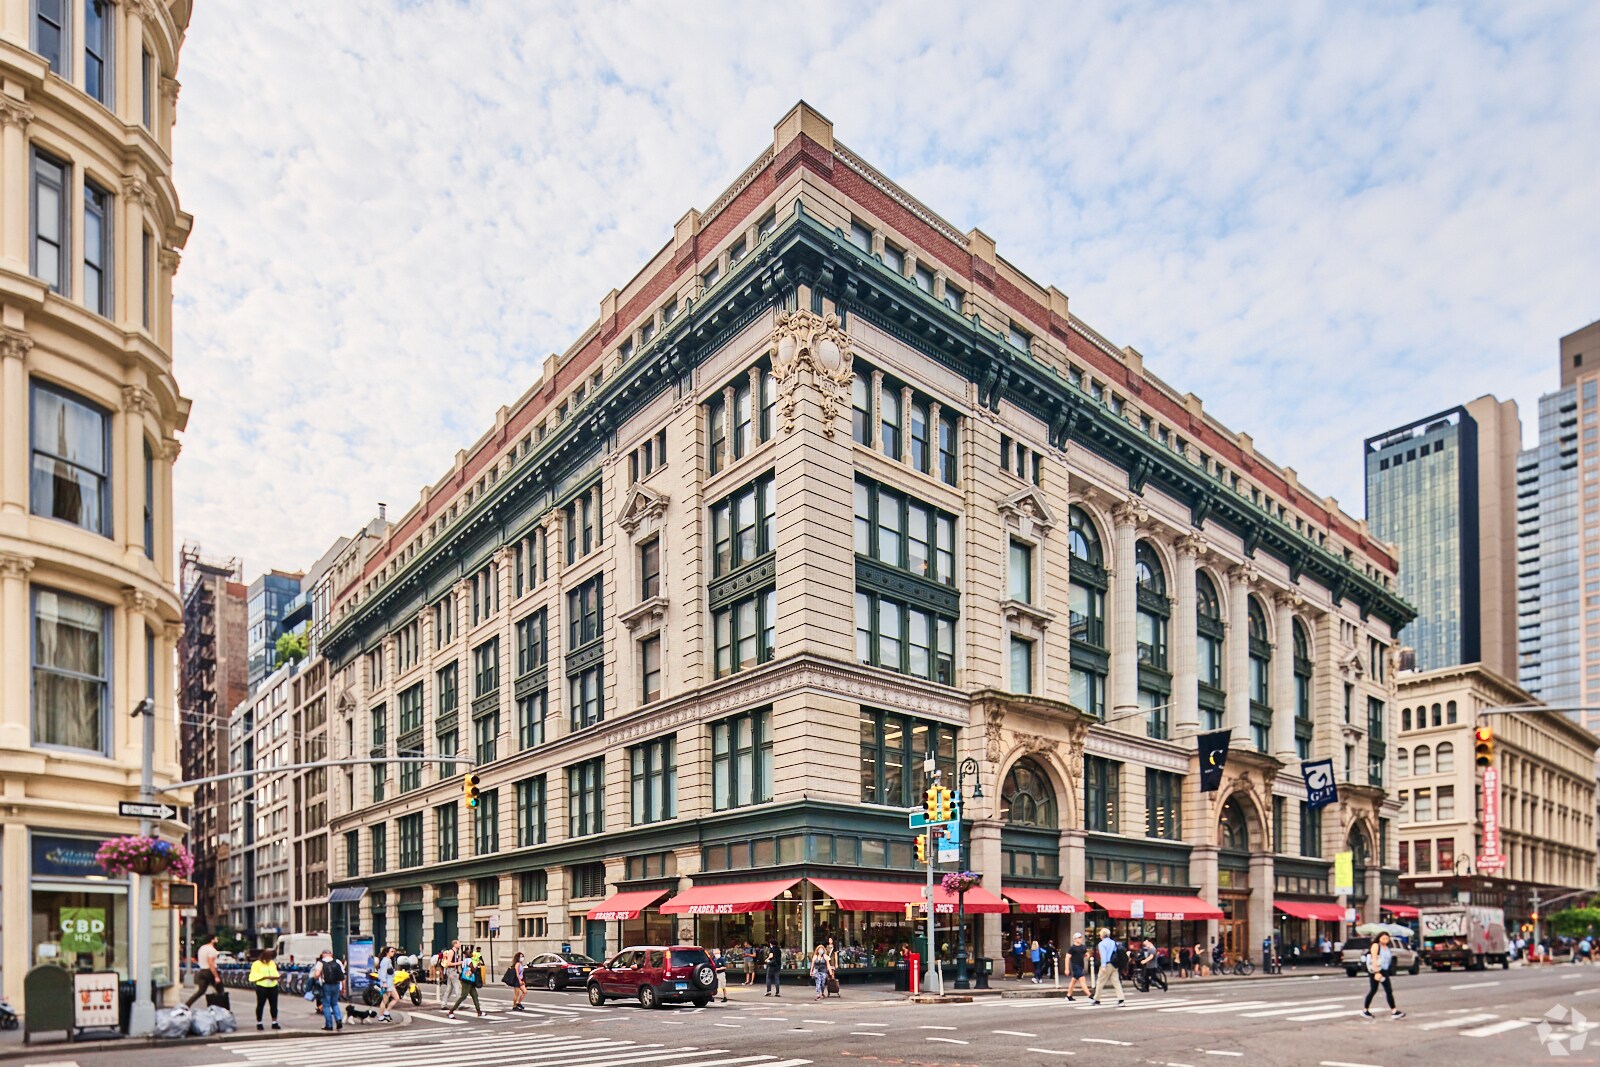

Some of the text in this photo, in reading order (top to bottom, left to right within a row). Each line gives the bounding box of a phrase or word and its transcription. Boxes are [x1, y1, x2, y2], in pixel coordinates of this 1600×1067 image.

[127, 805, 143, 815] ONE
[57, 848, 96, 859] Vitam
[53, 856, 97, 866] Shopp
[687, 904, 733, 914] TRADER JOE'S
[936, 903, 954, 913] JOE'S
[1036, 904, 1076, 913] TRADER JOE'S
[594, 911, 630, 920] TRADER JOE'S
[61, 919, 105, 933] CBD
[74, 934, 91, 942] HQ
